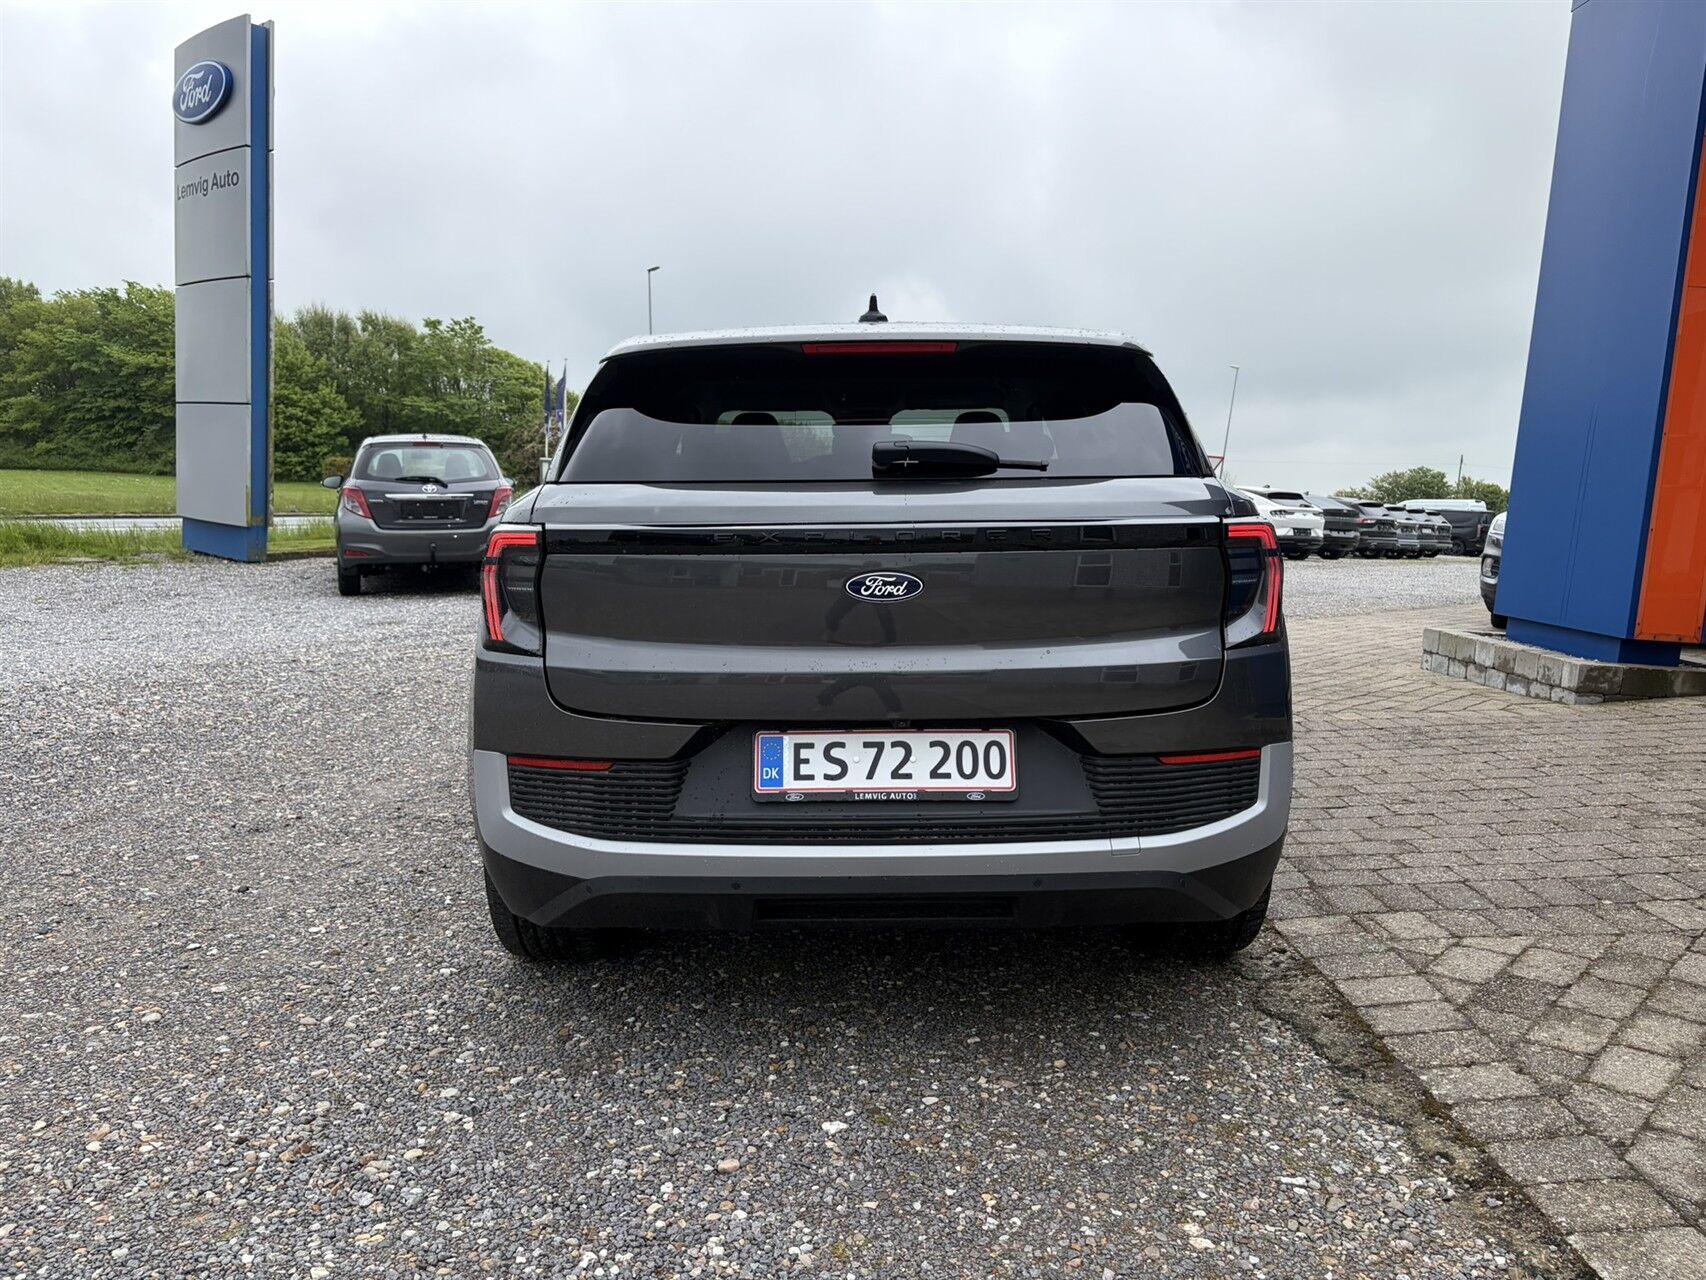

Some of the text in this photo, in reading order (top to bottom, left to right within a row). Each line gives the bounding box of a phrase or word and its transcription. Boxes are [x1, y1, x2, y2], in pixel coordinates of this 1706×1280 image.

[179, 70, 213, 112] Ford
[177, 169, 240, 201] Lemvig Auto
[860, 576, 907, 597] Ford
[763, 767, 780, 779] DK
[793, 740, 1007, 781] ES 72 200
[854, 792, 888, 800] LEMVIG
